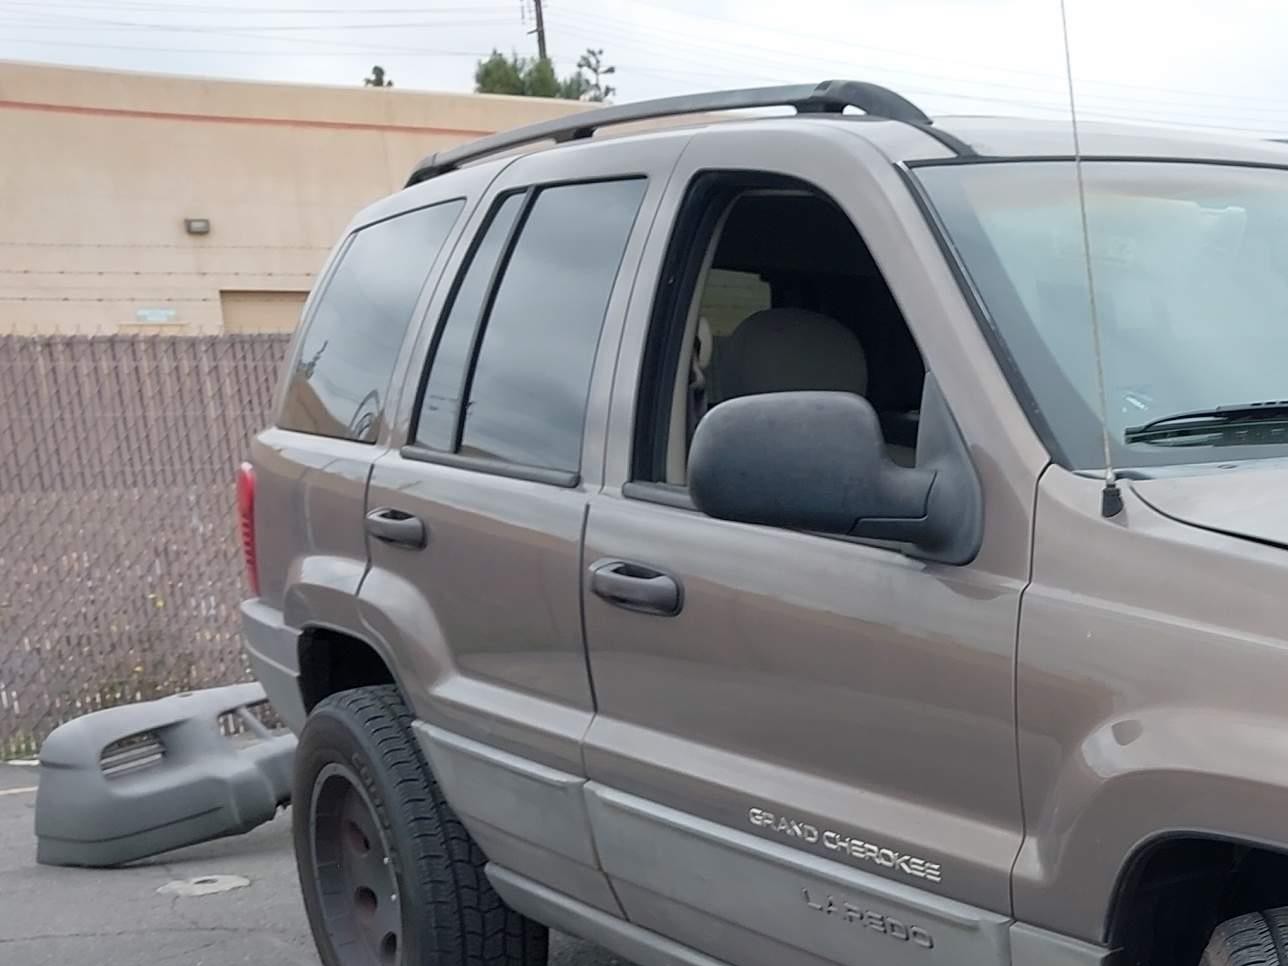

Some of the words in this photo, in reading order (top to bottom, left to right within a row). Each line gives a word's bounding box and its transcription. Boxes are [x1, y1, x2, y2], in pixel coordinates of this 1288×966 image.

[749, 807, 819, 843] GRAND
[822, 831, 942, 882] CHEROKEE
[802, 887, 935, 950] LAREDO
